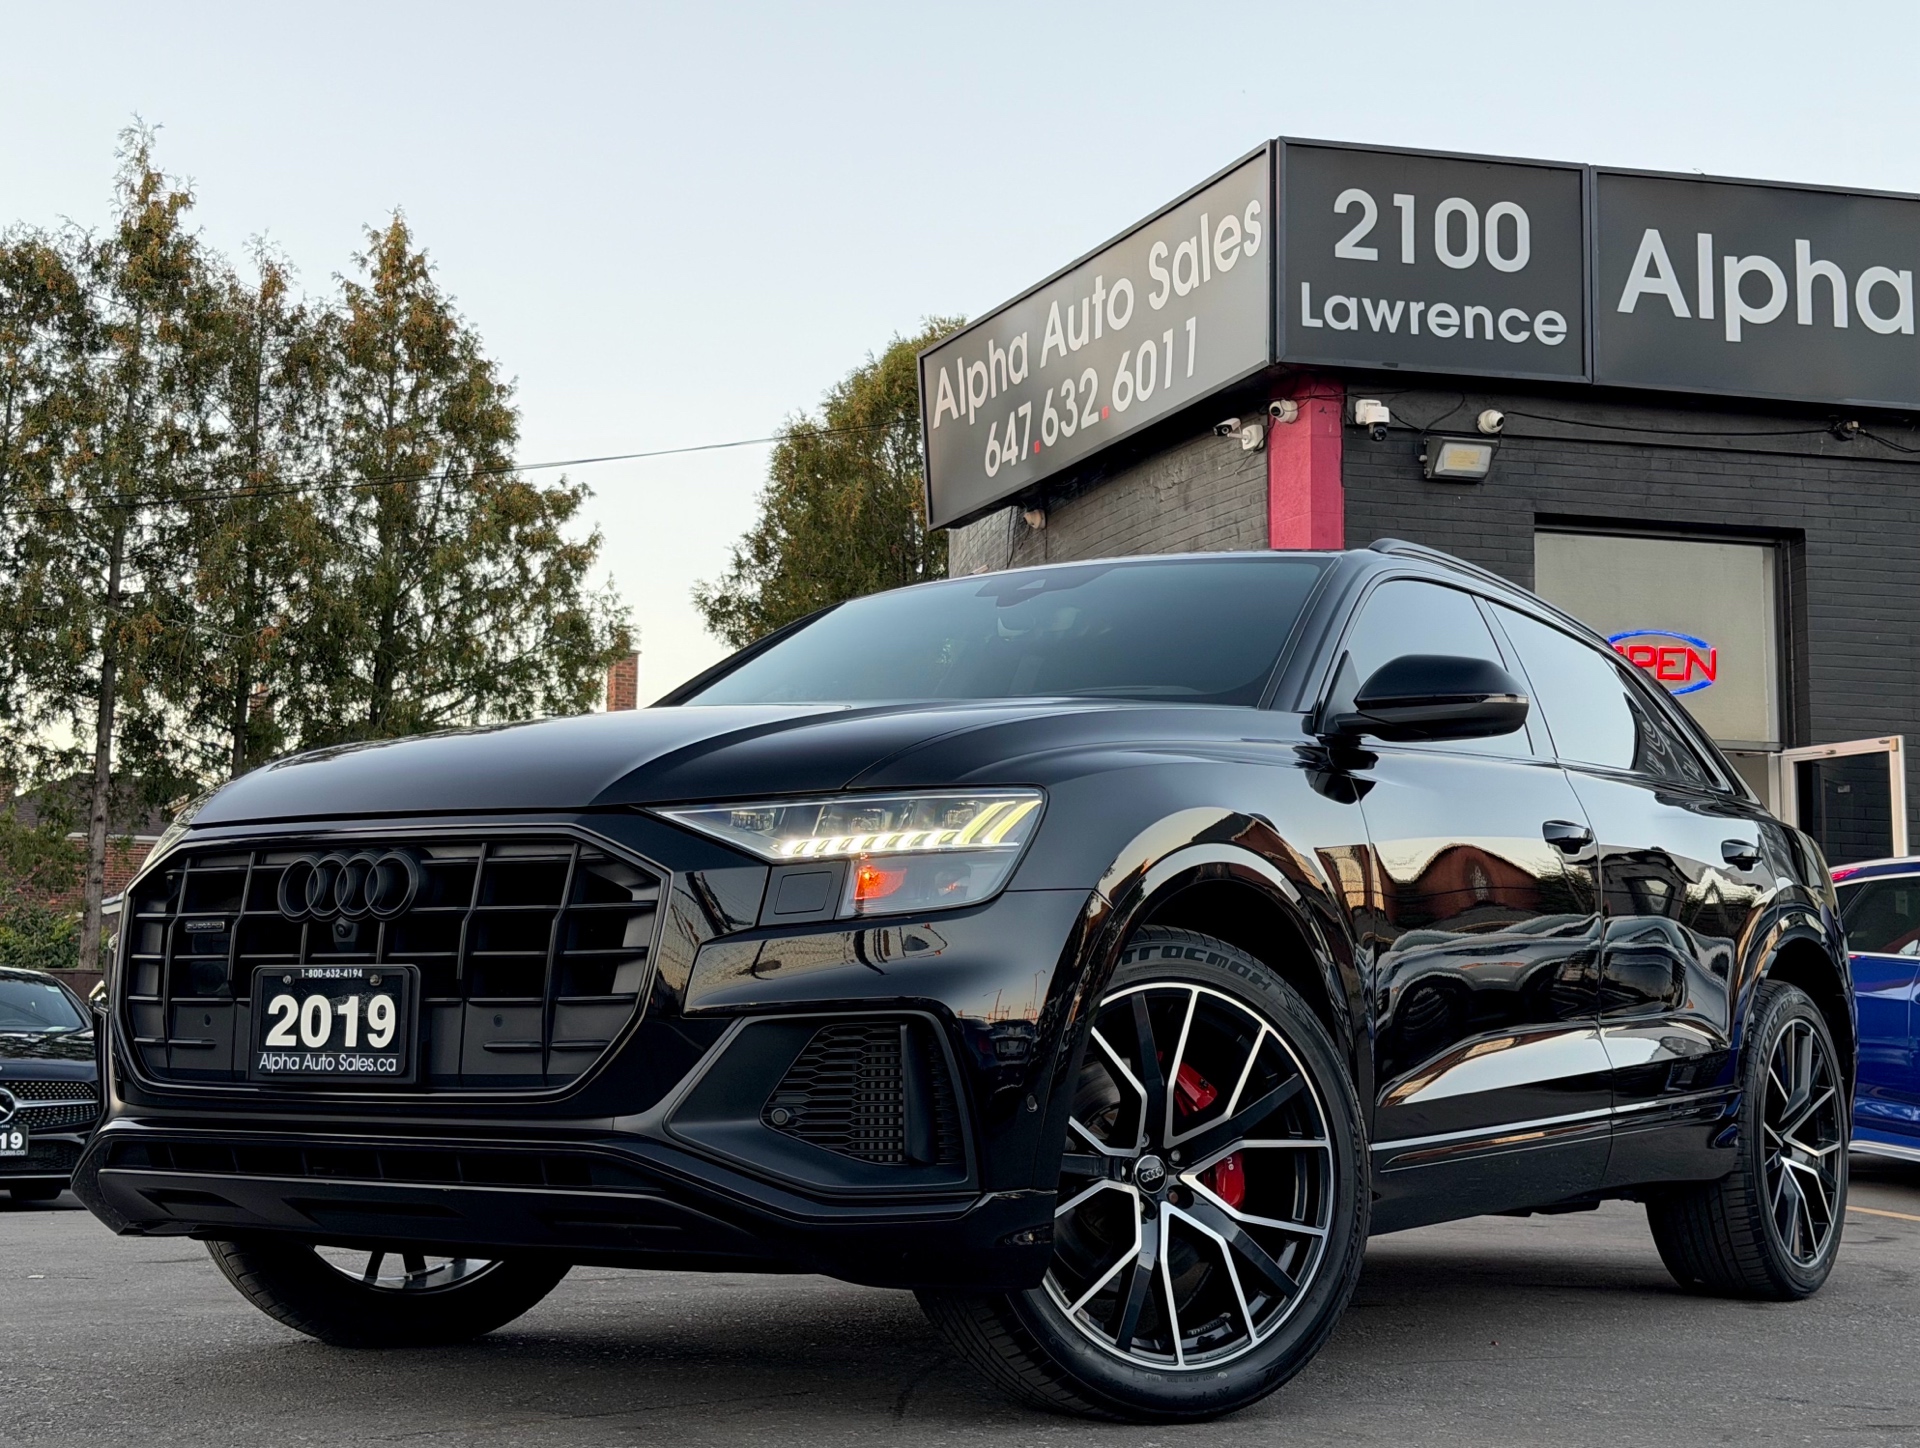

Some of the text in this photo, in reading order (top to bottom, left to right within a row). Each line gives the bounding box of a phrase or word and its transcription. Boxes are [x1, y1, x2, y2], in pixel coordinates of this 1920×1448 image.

[1333, 188, 1530, 273] 2100
[933, 199, 1262, 429] Alpha Auto Sales
[1301, 282, 1568, 346] Lawrence
[1617, 228, 1914, 342] Alpha
[985, 317, 1196, 478] 647.632.6011
[301, 969, 363, 978] 1-800-632-4194
[266, 994, 396, 1048] 2019
[259, 1053, 396, 1073] Alpha Auto Sales.ca
